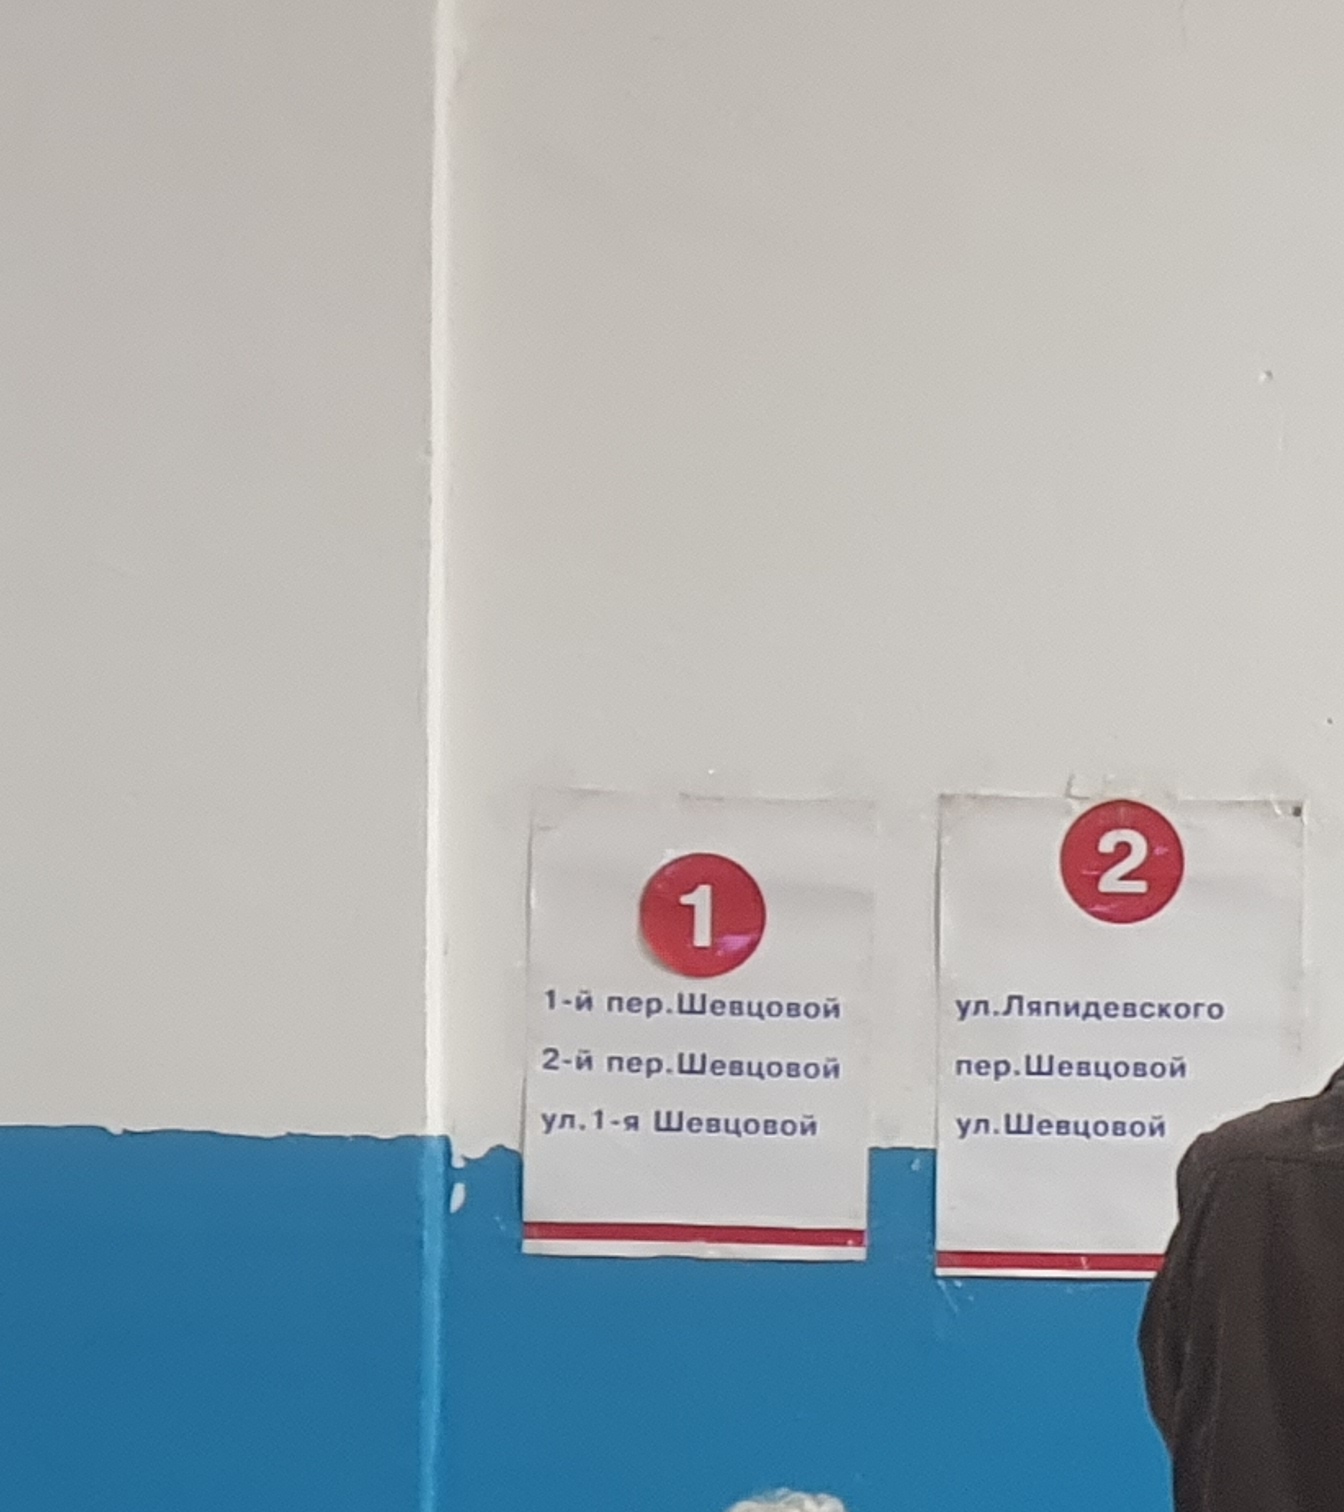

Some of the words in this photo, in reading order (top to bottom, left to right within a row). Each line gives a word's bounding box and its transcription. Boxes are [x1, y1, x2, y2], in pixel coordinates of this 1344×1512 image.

[1097, 828, 1149, 894] 2
[679, 884, 713, 949] 1
[544, 989, 594, 1013] 1-й
[541, 1047, 594, 1073] 2-й
[653, 1109, 819, 1139] Шевцовой
